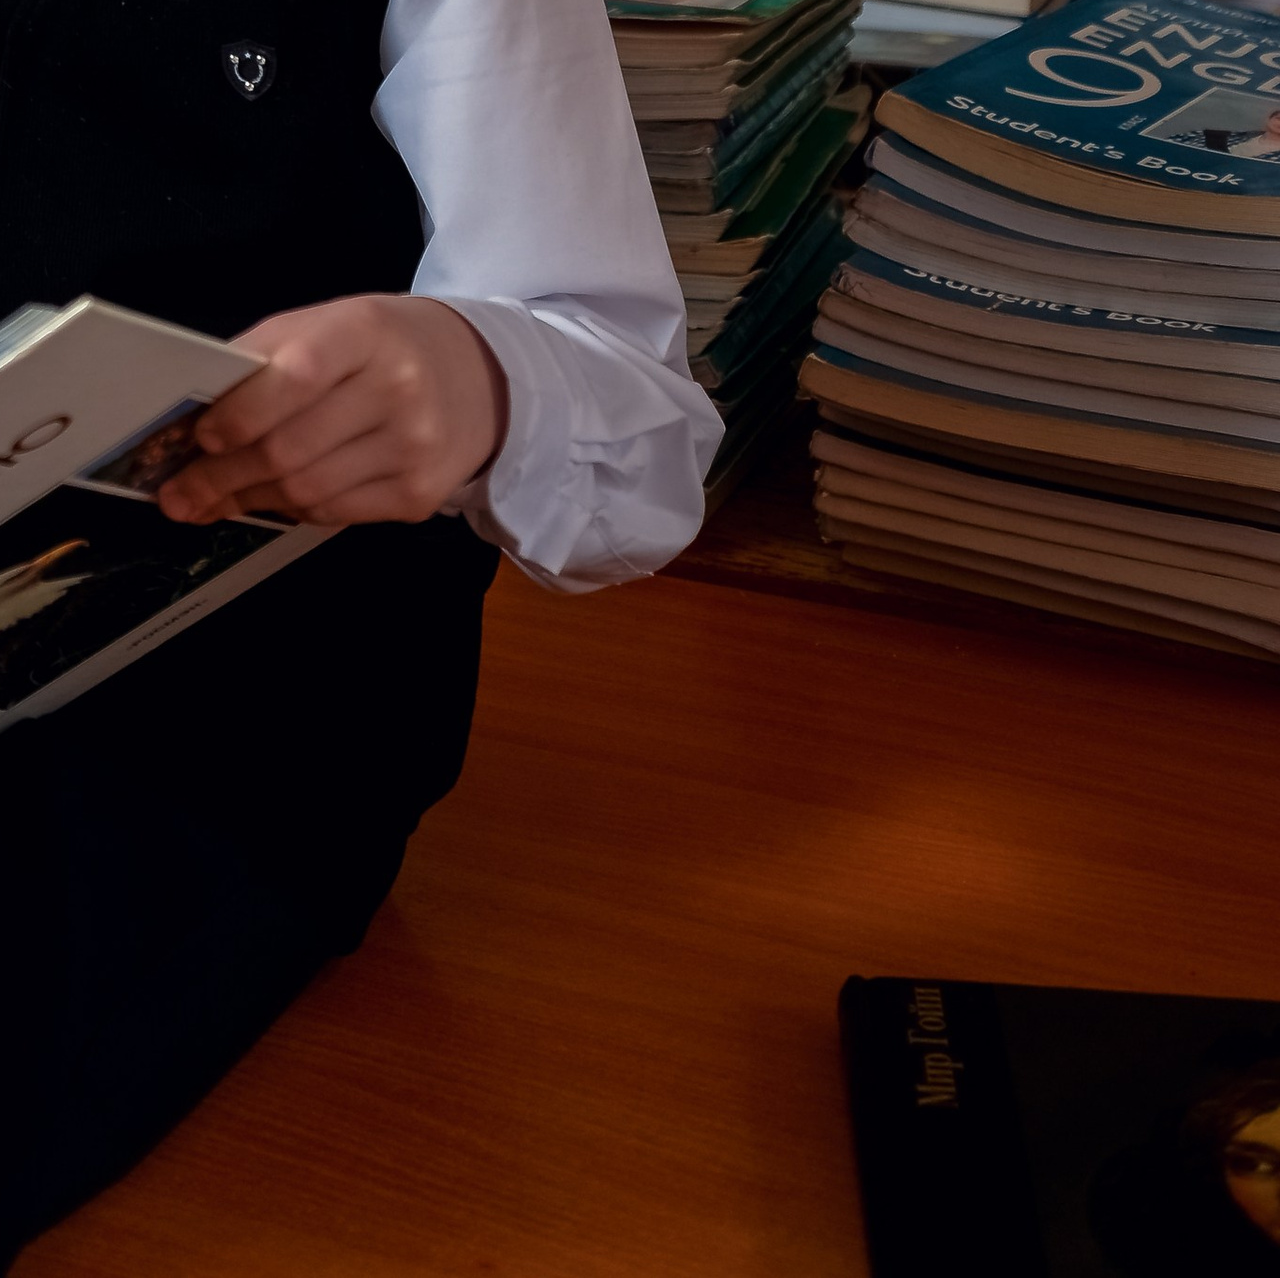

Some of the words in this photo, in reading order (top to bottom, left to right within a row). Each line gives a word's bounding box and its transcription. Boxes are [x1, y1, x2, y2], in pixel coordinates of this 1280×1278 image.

[1004, 46, 1162, 108] 9
[945, 94, 1126, 161] Student's
[1135, 154, 1245, 187] Book
[906, 985, 949, 1046] Гойи
[913, 1051, 966, 1111] Мир
